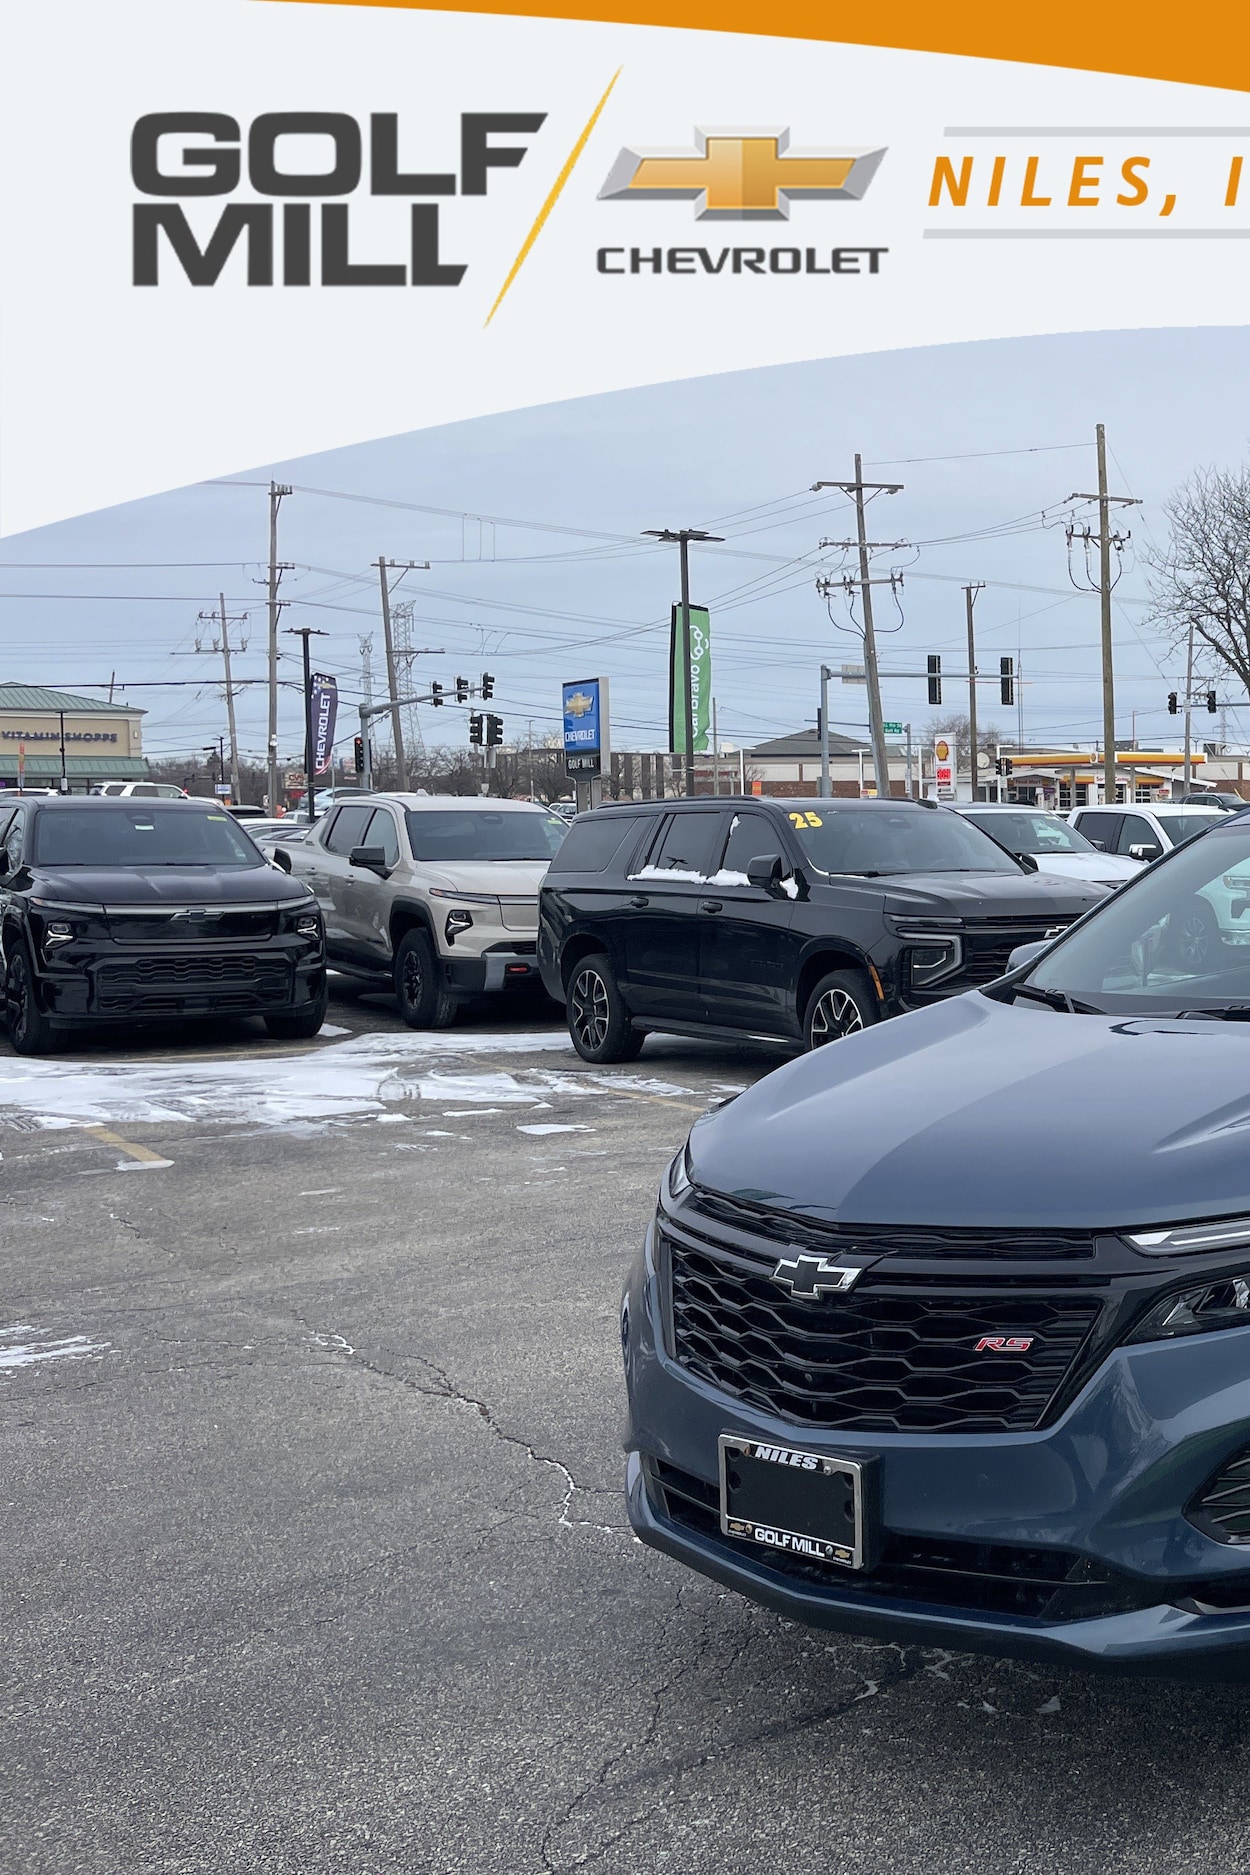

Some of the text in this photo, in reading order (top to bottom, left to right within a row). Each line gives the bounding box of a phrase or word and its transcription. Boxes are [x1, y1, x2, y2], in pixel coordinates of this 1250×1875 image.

[1, 730, 118, 743] VITAMIN SHOPPE
[315, 692, 331, 769] CHEVROLET
[565, 729, 595, 743] CHEVROLET
[568, 759, 581, 770] GOLF
[788, 811, 823, 829] 25
[974, 1337, 1034, 1352] RS
[754, 1445, 819, 1471] NILES
[754, 1527, 826, 1558] GOLF MILL
